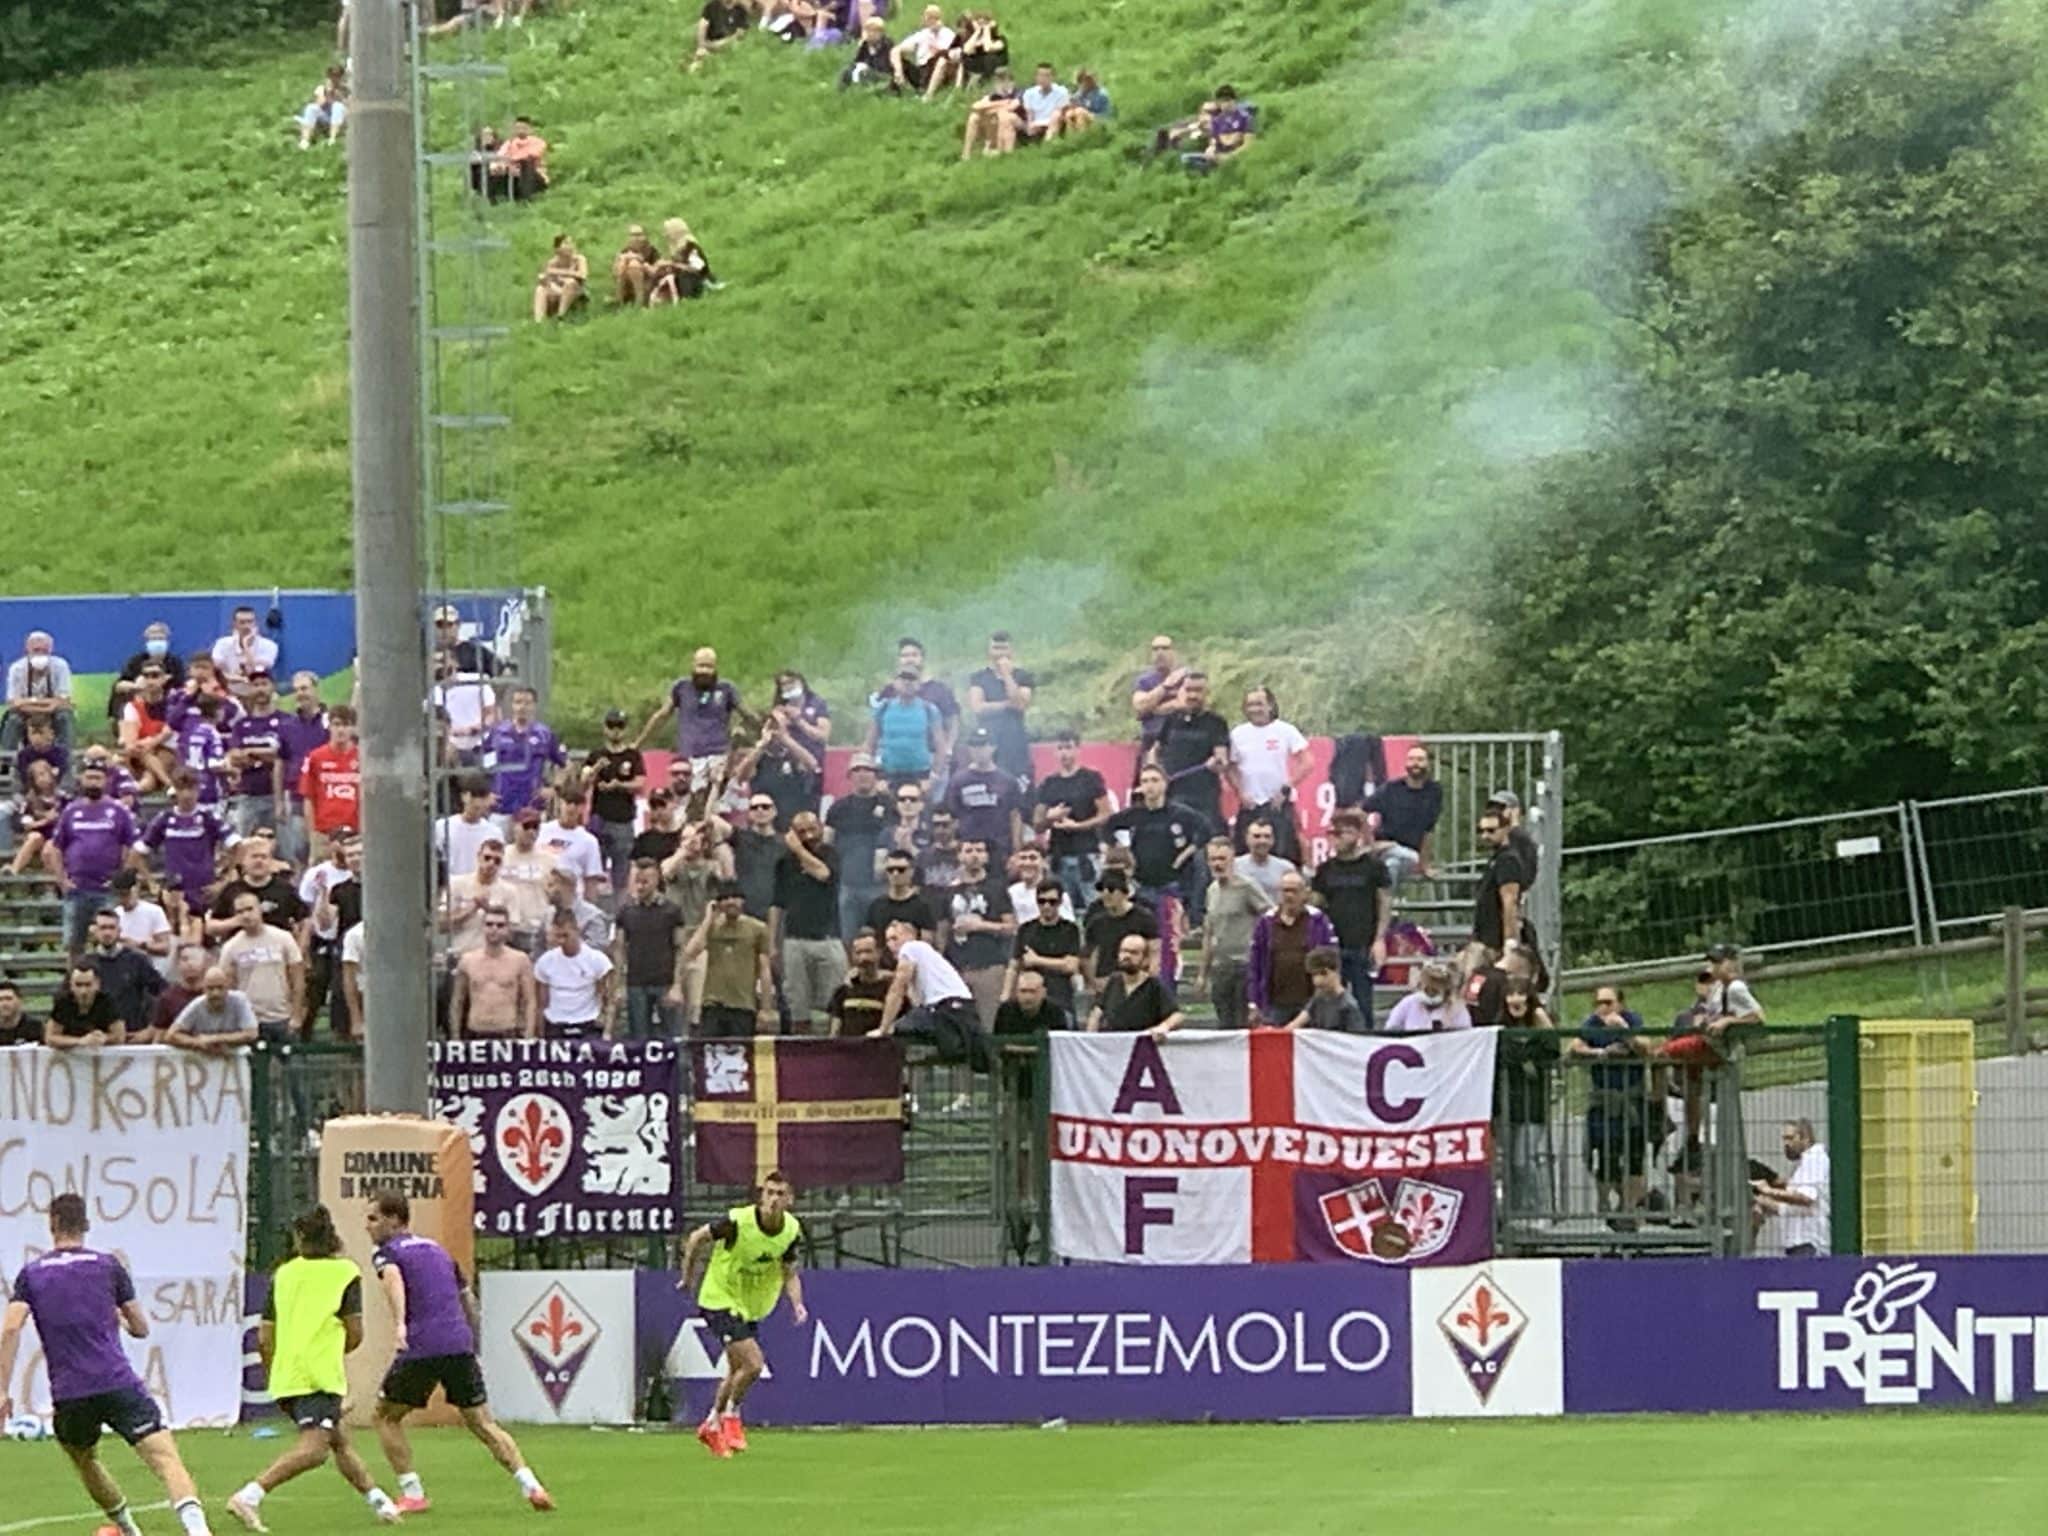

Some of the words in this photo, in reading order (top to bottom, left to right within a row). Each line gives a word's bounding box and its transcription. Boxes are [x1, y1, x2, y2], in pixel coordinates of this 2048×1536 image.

[1112, 1035, 1183, 1115] A
[1366, 1044, 1425, 1123] C
[344, 1151, 440, 1174] COMUNE
[1056, 1121, 1486, 1170] UNONOVEDUESEI
[497, 1202, 527, 1232] of
[534, 1202, 674, 1237] Florence
[1125, 1176, 1178, 1255] F
[810, 1311, 1391, 1377] MONTEZEMOLO
